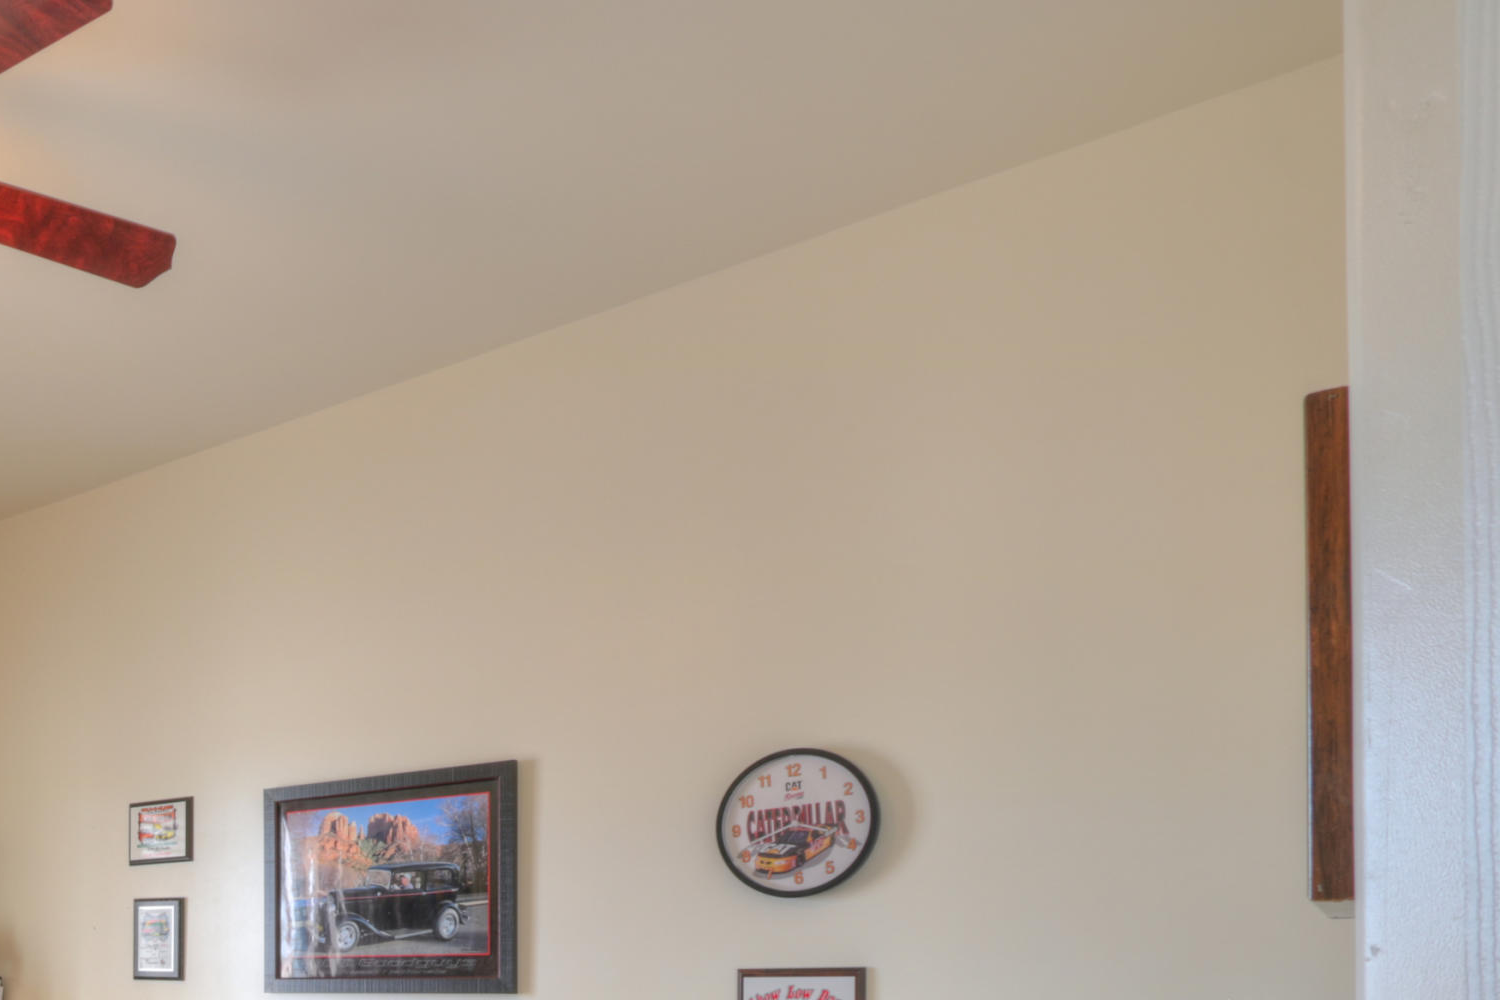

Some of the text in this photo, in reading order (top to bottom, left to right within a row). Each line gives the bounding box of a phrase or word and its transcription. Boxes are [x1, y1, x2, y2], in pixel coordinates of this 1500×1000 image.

[785, 763, 802, 777] 12
[819, 766, 828, 779] 1
[757, 774, 772, 788] 11
[785, 780, 803, 792] CAT
[843, 782, 854, 796] 2
[739, 795, 755, 808] 10
[746, 800, 849, 845] CATERPILLAR
[855, 809, 866, 824] 3
[731, 824, 742, 838] 9
[847, 838, 857, 851] 4
[741, 849, 752, 863] 8
[825, 861, 835, 875] 5
[794, 871, 804, 885] 6
[786, 985, 815, 1000] Low
